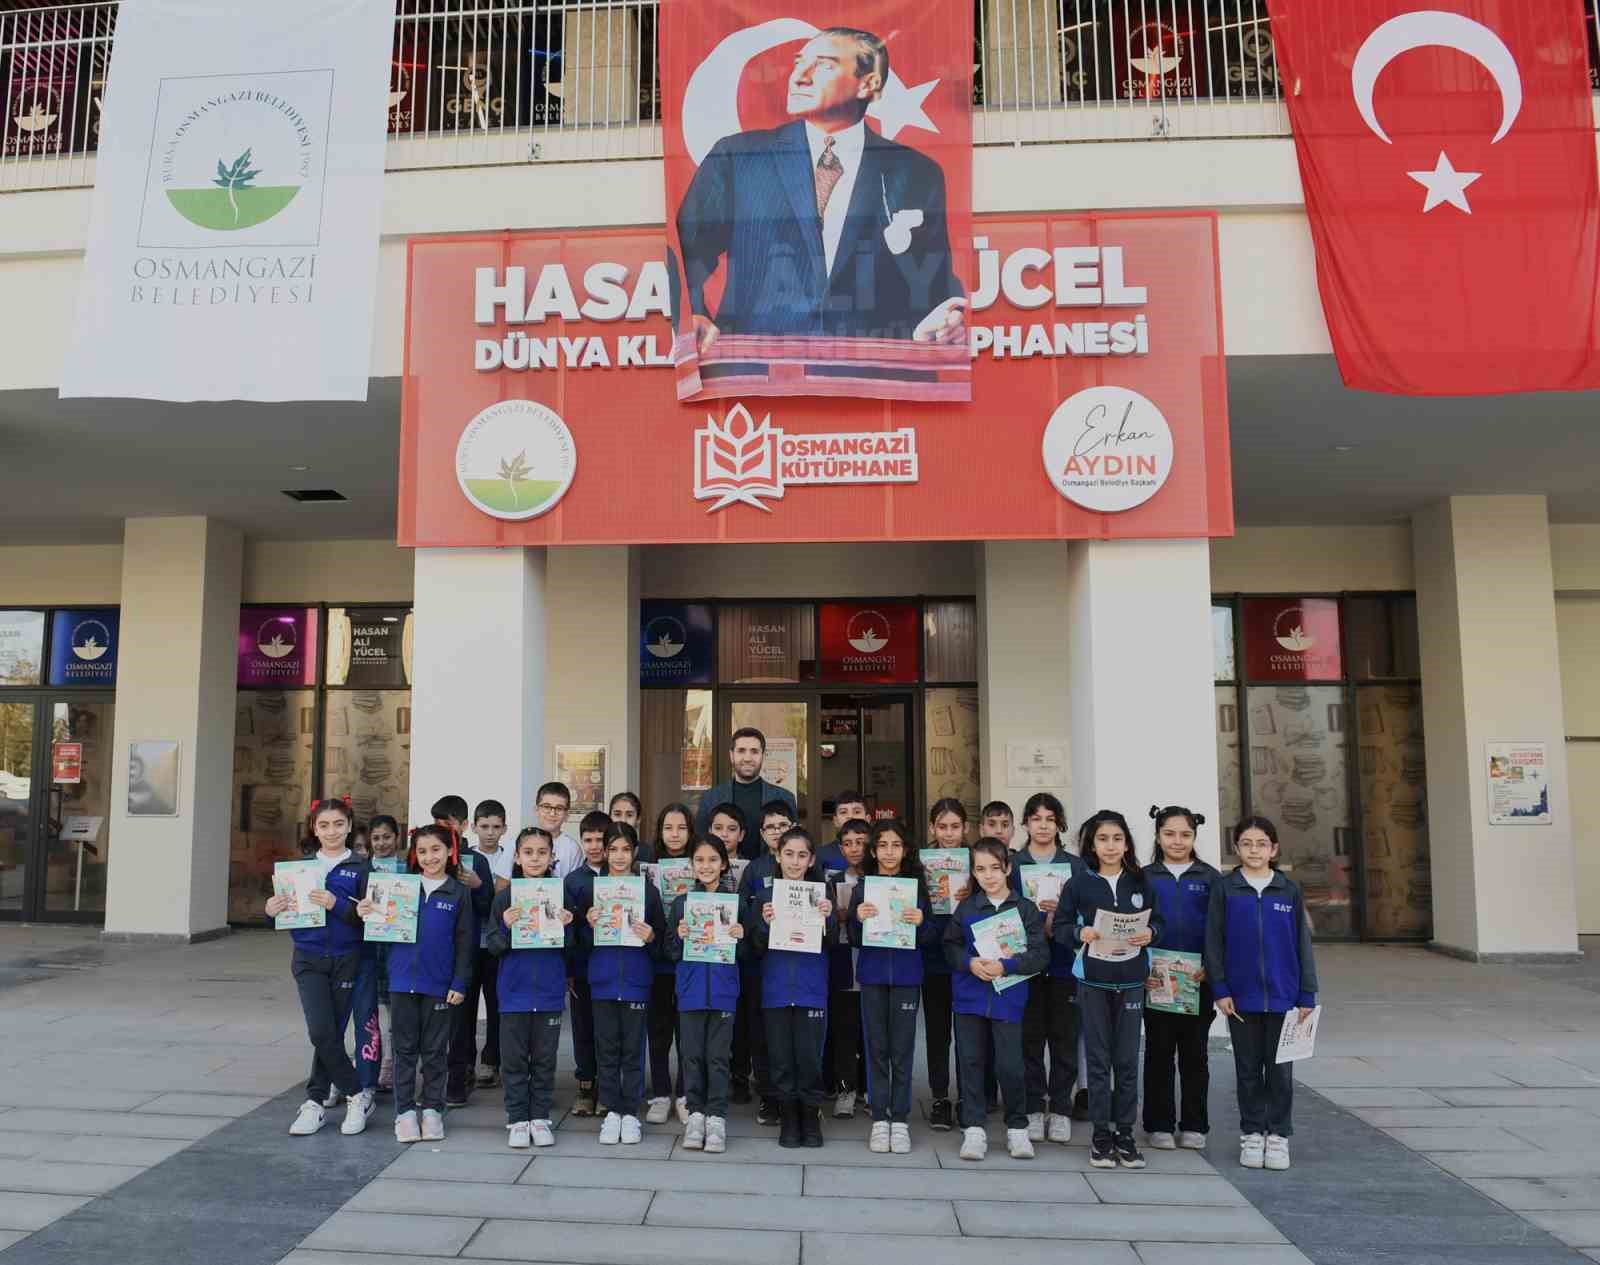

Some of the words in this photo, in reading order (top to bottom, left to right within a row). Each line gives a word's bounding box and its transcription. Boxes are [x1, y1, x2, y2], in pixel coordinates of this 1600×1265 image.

[133, 254, 318, 281] OSMANGAZİ
[130, 283, 314, 306] BELEDİYESİ
[474, 261, 674, 324] HASA
[475, 331, 612, 371] DÜNYA
[1072, 400, 1156, 457] Erkan
[781, 433, 910, 457] OSMANGAZİ
[781, 457, 913, 478] KÜTÜPHANE
[1063, 454, 1158, 476] AYDIN
[353, 626, 389, 636] HASAN
[353, 636, 370, 646] ALİ
[353, 645, 388, 657] YÜCEL
